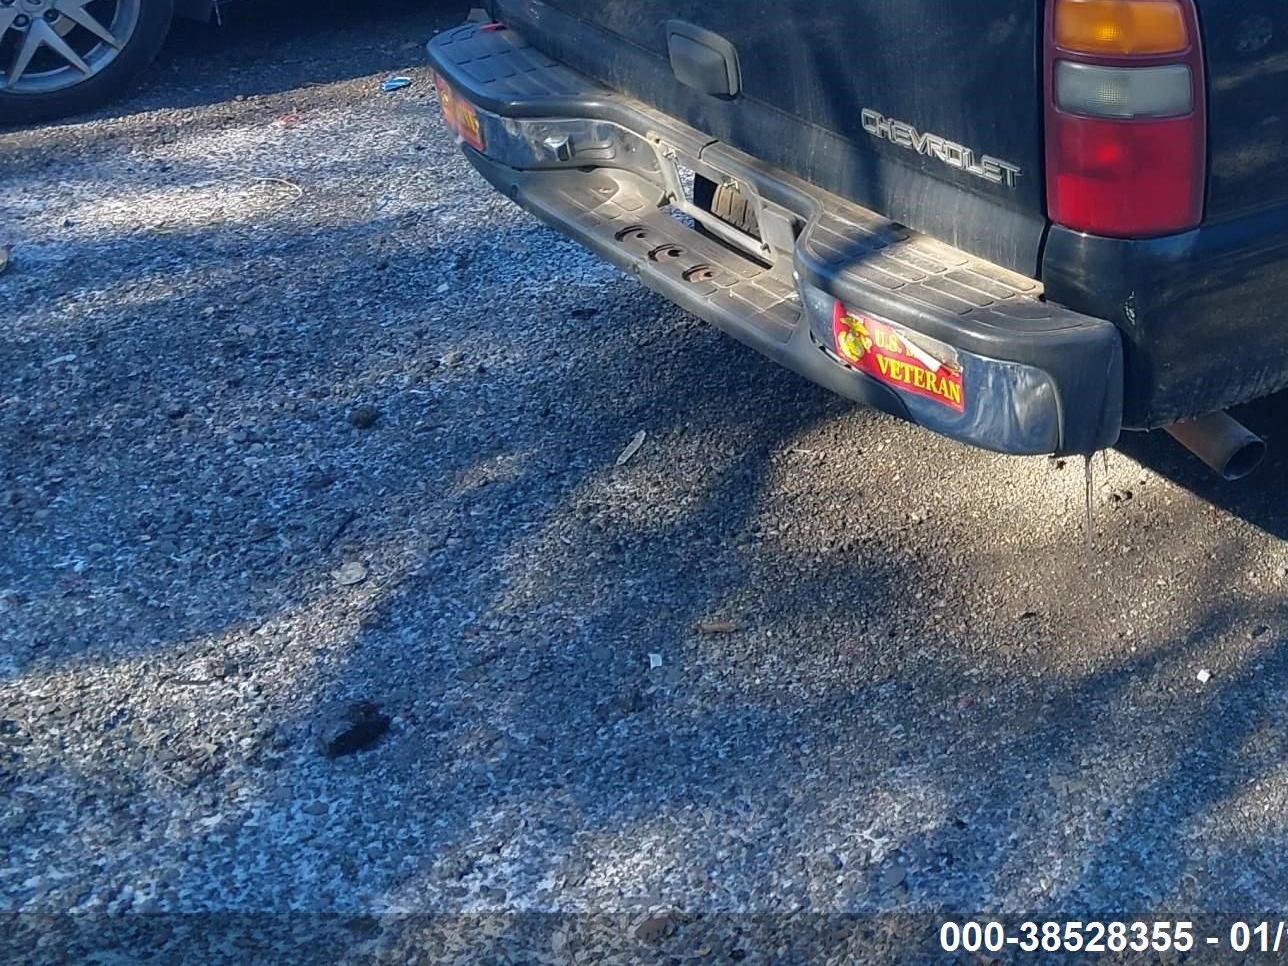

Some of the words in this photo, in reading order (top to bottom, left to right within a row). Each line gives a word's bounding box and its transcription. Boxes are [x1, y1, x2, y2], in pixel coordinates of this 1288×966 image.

[860, 107, 1023, 188] CHEVROLET
[874, 328, 903, 354] U.S.
[875, 353, 961, 404] VETERAN
